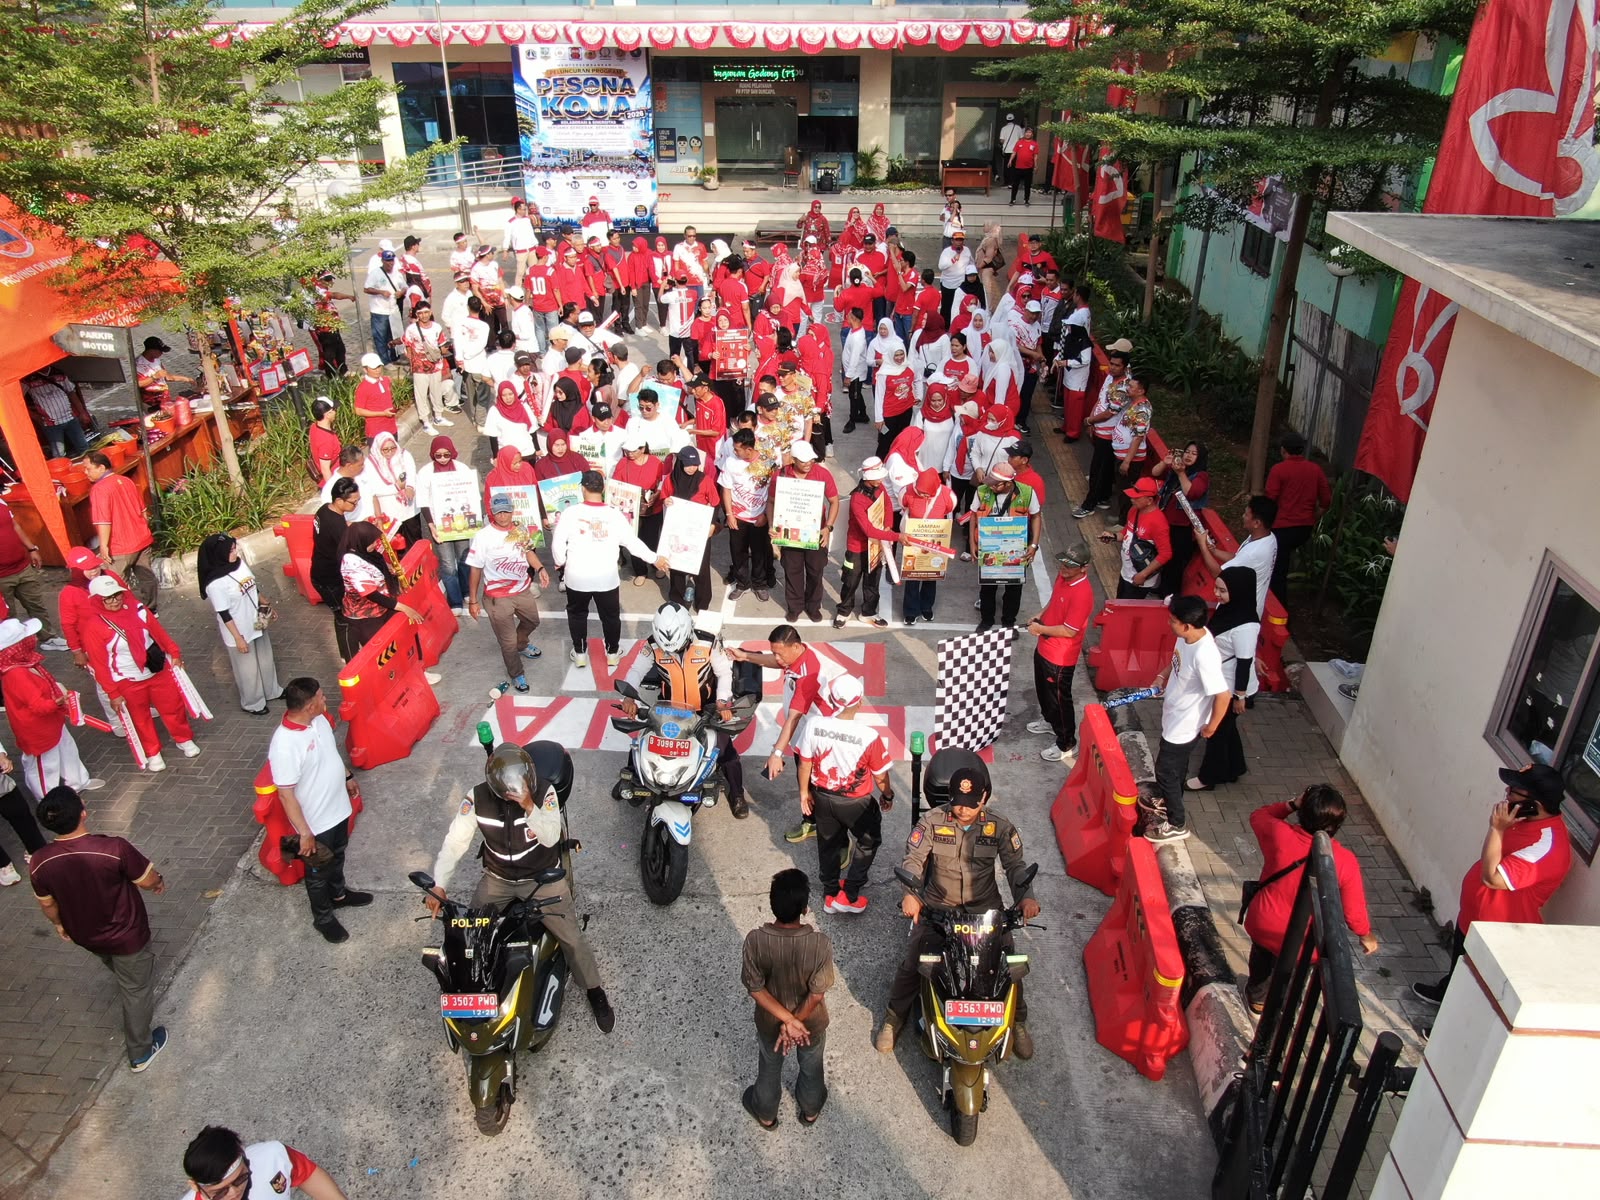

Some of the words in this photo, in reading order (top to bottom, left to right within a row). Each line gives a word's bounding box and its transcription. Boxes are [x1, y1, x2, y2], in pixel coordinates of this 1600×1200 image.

[748, 69, 779, 79] Gedung
[536, 77, 635, 96] PESONA
[540, 95, 632, 119] KOJA
[531, 276, 547, 296] 10
[80, 331, 114, 341] PARKIR
[82, 341, 115, 351] MOTOR
[814, 728, 863, 746] INDONESIA
[451, 918, 473, 928] POL
[475, 917, 490, 928] PP
[954, 924, 976, 935] POL
[979, 925, 994, 935] PP
[442, 997, 448, 1006] B
[453, 997, 474, 1007] 3502
[947, 1003, 954, 1013] B
[958, 1003, 981, 1013] 3563
